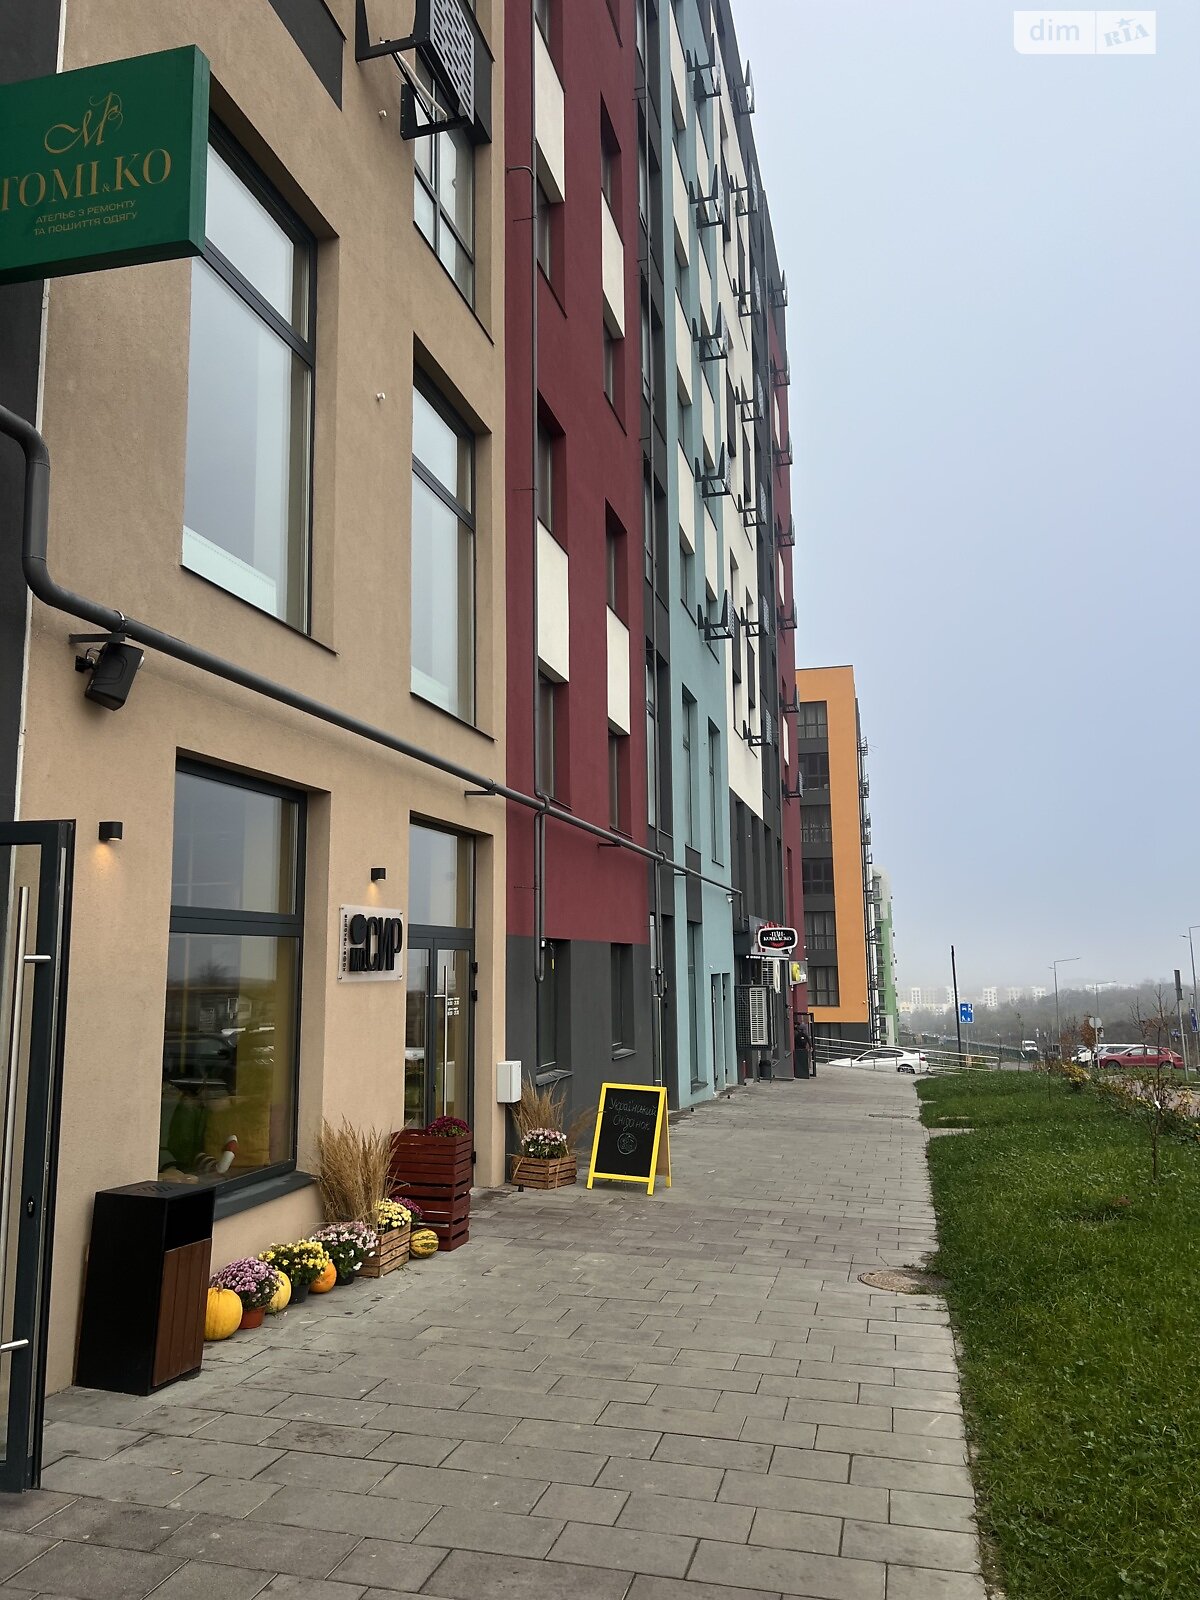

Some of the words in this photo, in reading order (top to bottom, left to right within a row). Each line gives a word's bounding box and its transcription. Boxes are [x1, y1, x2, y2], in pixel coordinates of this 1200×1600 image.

[33, 228, 46, 236] ТА
[48, 217, 101, 234] ПОШИТТЯ
[103, 211, 138, 224] ОДЯГУ
[36, 210, 76, 224] АТЕЛЬЄ
[87, 200, 136, 215] РЕМОНТУ
